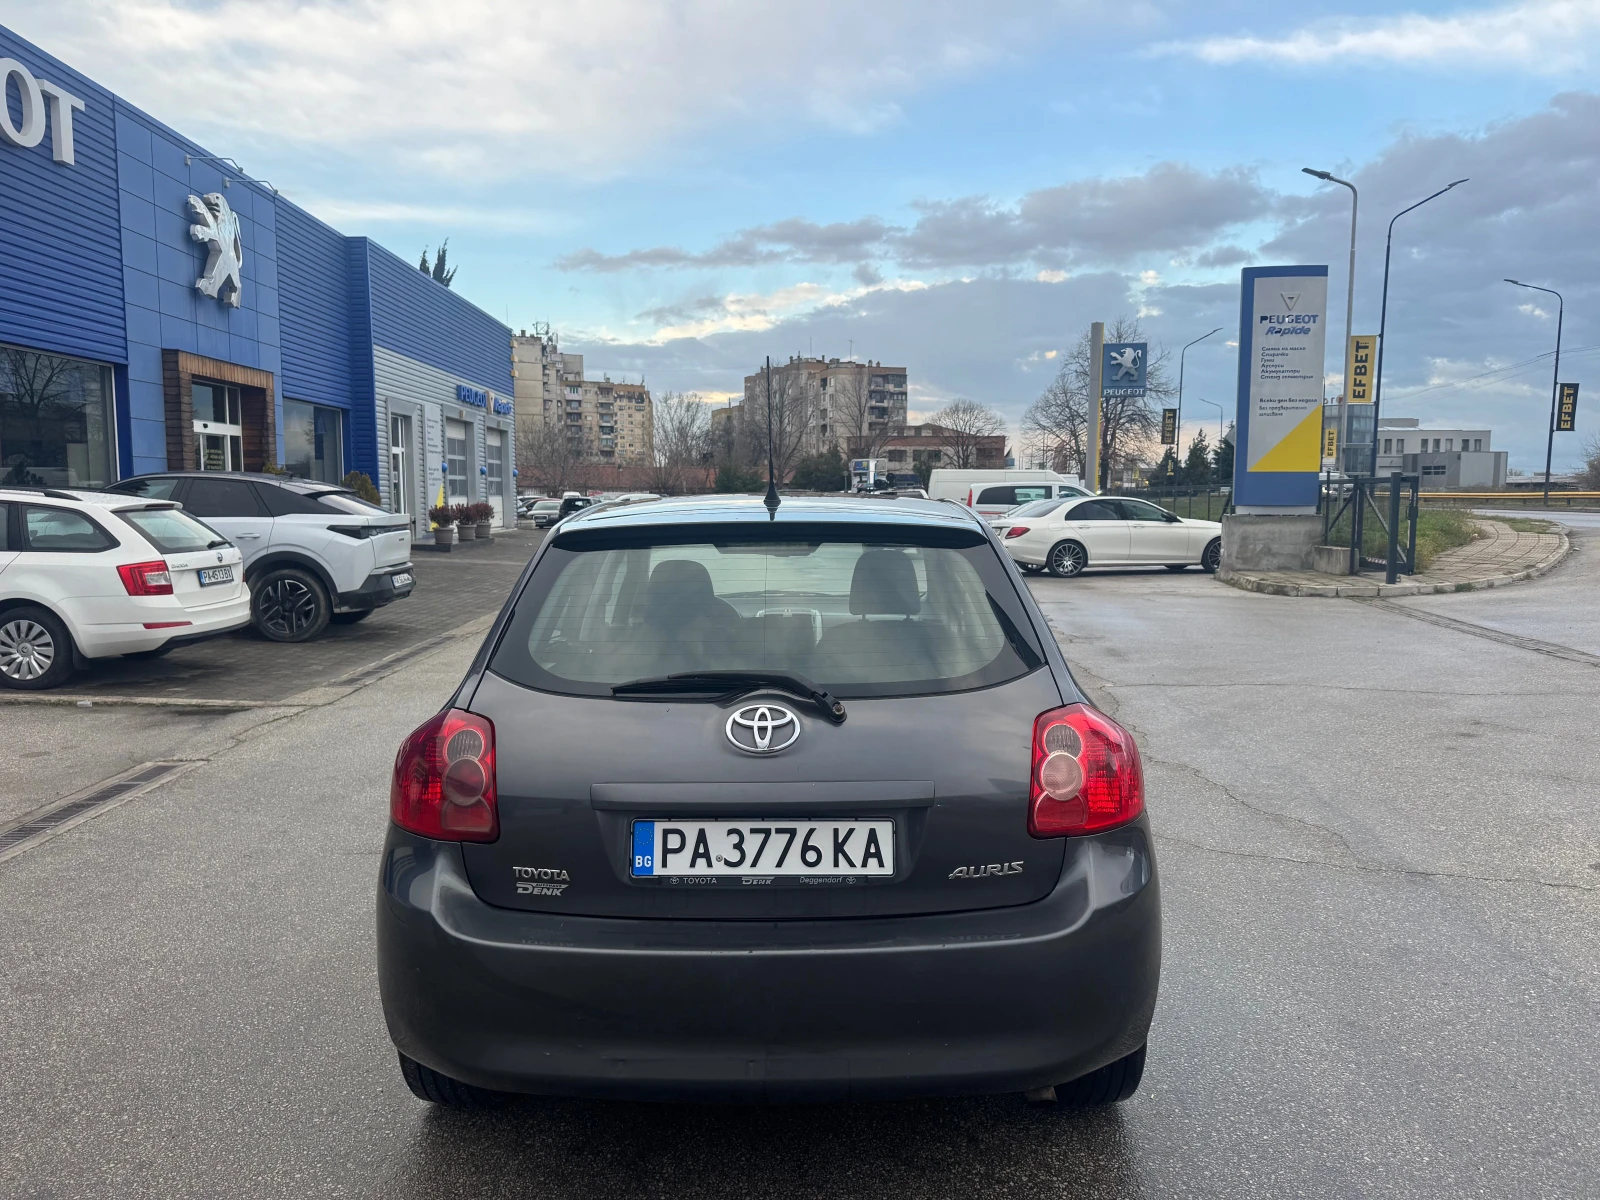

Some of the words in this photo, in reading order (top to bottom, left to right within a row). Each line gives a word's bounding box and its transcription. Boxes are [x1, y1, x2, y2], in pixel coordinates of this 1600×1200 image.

[1260, 314, 1319, 324] PEUGEOT
[1352, 340, 1370, 399] EFBET
[459, 385, 488, 408] PEUGEO
[1103, 388, 1145, 396] PEUGEOT
[1560, 386, 1575, 429] EFBET
[1164, 410, 1174, 443] EFBET
[1327, 430, 1335, 457] EFBET
[635, 856, 652, 867] BG
[948, 860, 1024, 880] AURIS
[512, 866, 571, 881] TOYOTA
[682, 877, 718, 885] TOYOTA
[799, 876, 843, 884] Deggendorf
